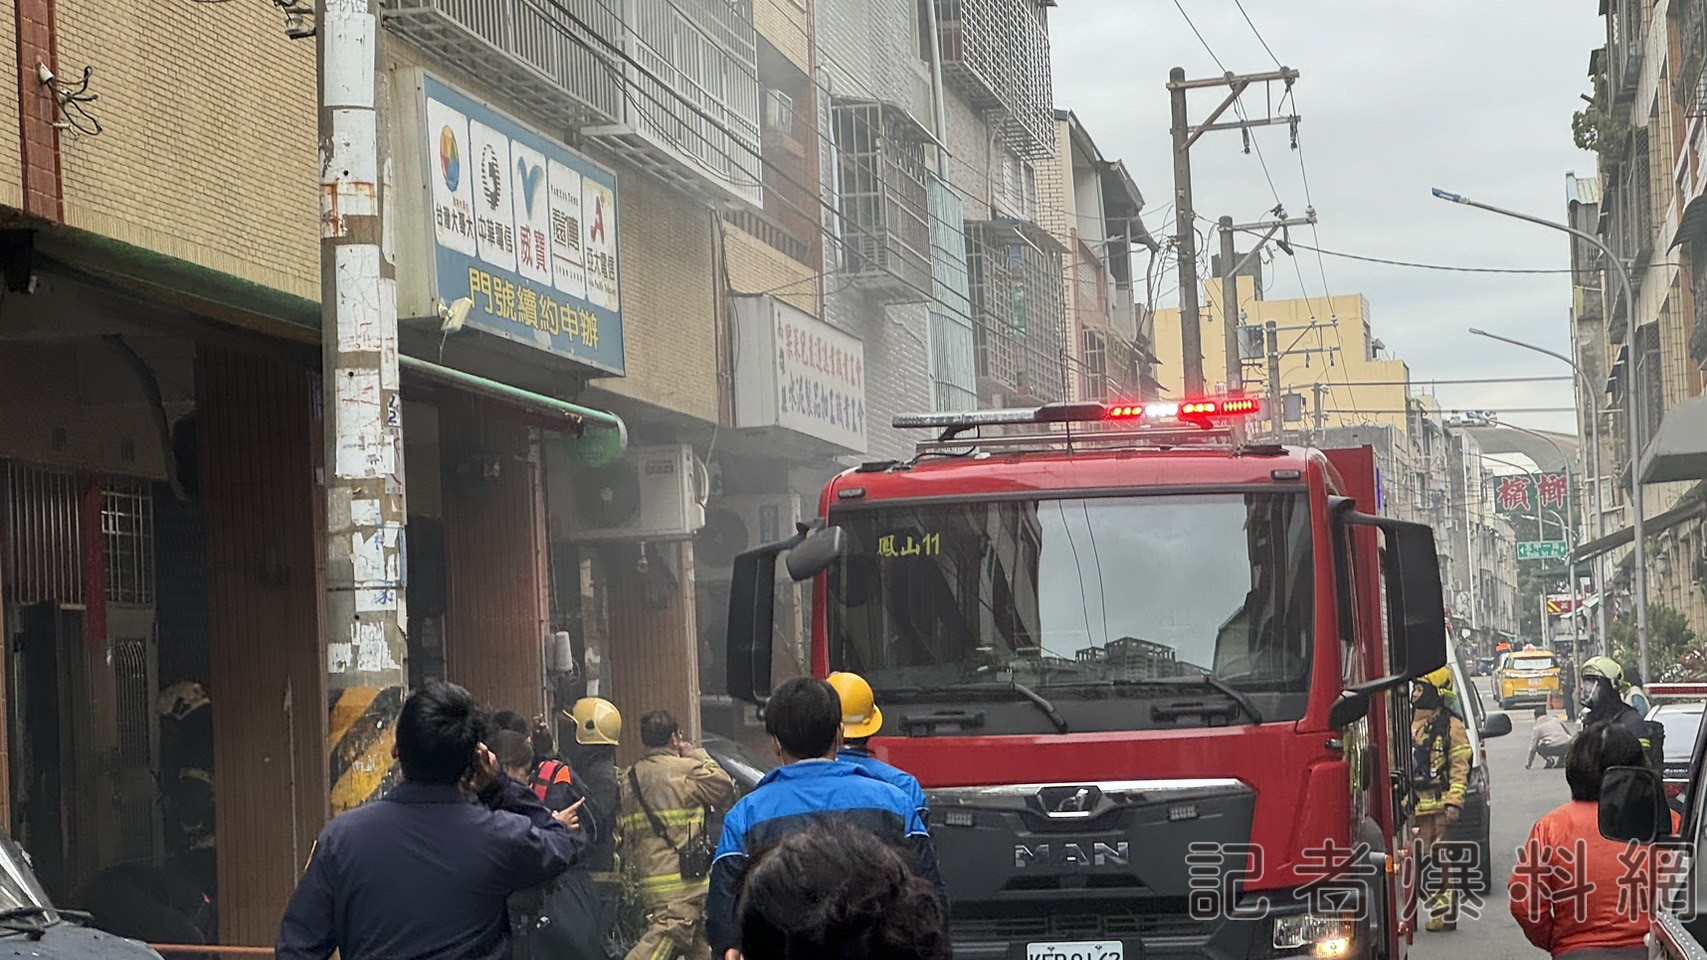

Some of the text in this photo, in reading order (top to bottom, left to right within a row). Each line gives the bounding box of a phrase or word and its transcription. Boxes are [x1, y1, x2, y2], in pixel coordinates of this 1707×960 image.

[435, 202, 474, 239] 台灣大哥大
[477, 214, 513, 253] 中華電信
[552, 207, 580, 252] 遠傳
[520, 223, 547, 274] 威寶
[586, 246, 615, 281] 亞太電信
[468, 267, 599, 350] 門號續約申辦
[1496, 473, 1567, 511] 檳榔
[1014, 842, 1129, 868] MAN
